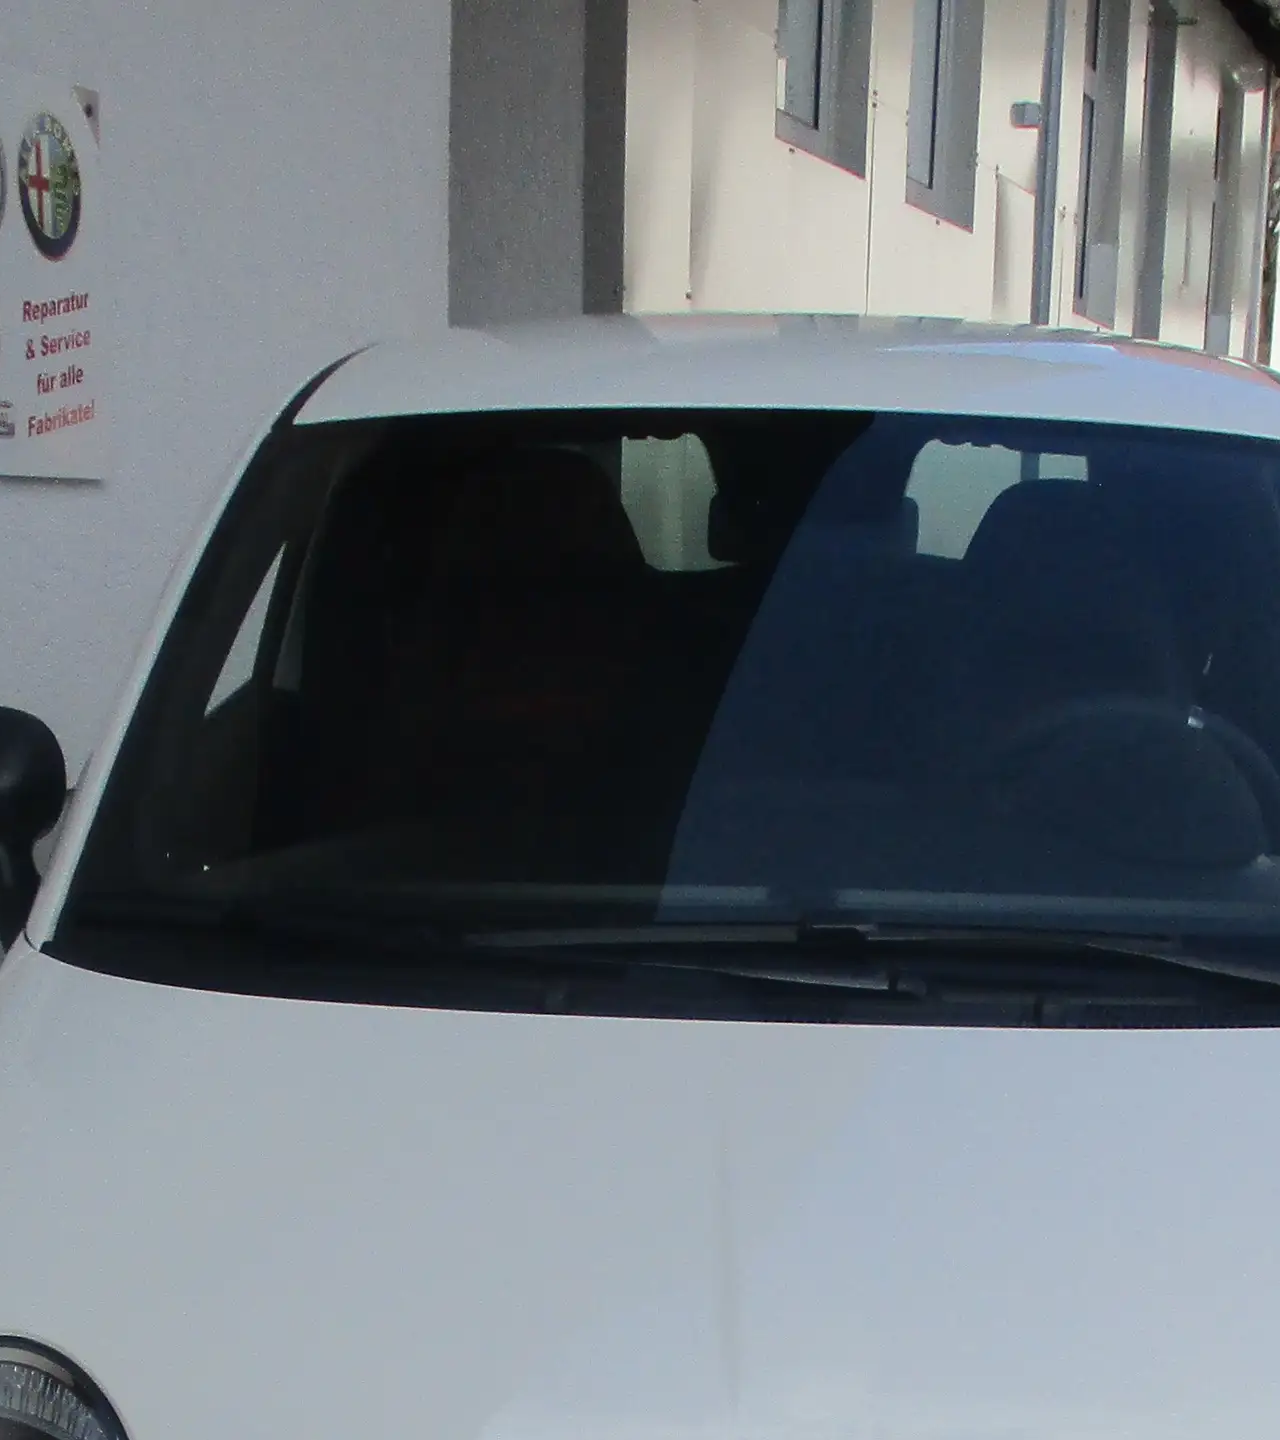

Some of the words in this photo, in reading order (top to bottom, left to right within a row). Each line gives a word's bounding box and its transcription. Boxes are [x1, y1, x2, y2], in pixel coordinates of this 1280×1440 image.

[22, 291, 89, 324] Reparatur
[25, 339, 36, 360] &
[40, 328, 91, 357] Service
[37, 370, 56, 395] für
[60, 364, 84, 389] alle
